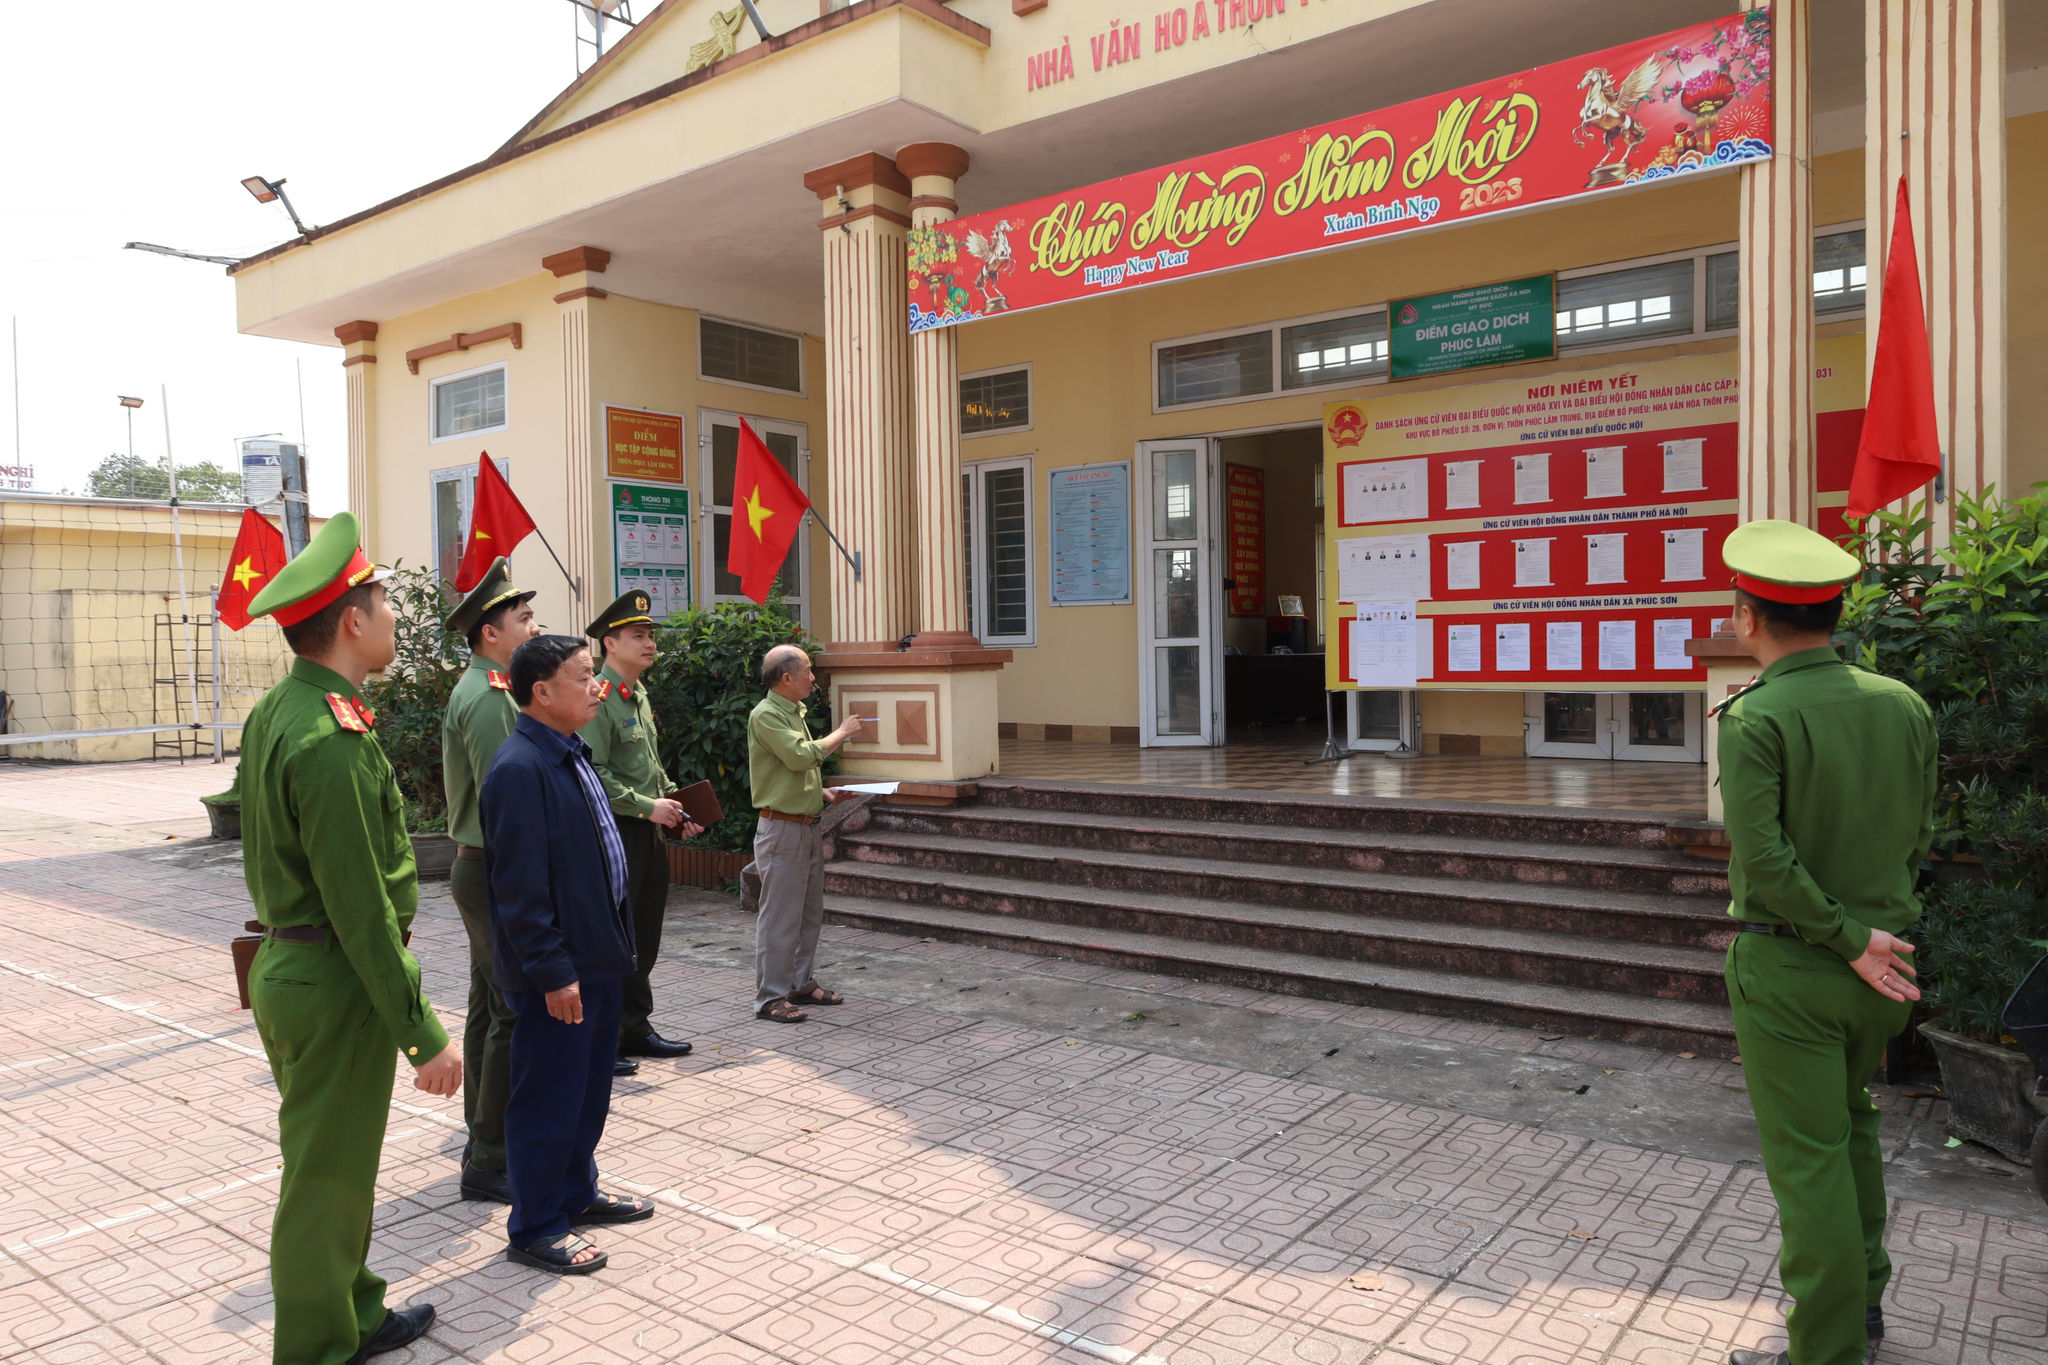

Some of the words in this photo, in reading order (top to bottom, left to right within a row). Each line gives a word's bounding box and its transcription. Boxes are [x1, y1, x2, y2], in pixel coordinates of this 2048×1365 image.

[1027, 35, 1075, 92] NHÀ
[1090, 18, 1141, 72] VĂN
[1029, 200, 1128, 278] Chúc
[1129, 164, 1268, 248] Mừng
[1273, 129, 1395, 217] Năm
[1401, 92, 1540, 190] Mới
[1323, 213, 1366, 237] Xuân
[1366, 201, 1403, 230] Bính
[1403, 195, 1440, 220] Ngọ
[1084, 263, 1125, 288] Happy
[1126, 256, 1157, 278] New
[1158, 248, 1190, 270] Year
[1415, 323, 1448, 341] ĐIỂM
[1451, 318, 1490, 336] GIAO
[1492, 311, 1530, 330] DỊCH
[1441, 336, 1473, 353] PHÚC
[1375, 420, 1394, 431] DANH
[1395, 417, 1413, 428] SÁCH
[1442, 411, 1457, 422] VIÊN
[1473, 406, 1489, 420] BIỂU
[1491, 404, 1510, 418] QUỐC
[1512, 402, 1525, 416] HỘI
[1526, 400, 1546, 412] KHÓA
[1549, 400, 1561, 411] XVI
[1563, 397, 1573, 409] VÀ
[1574, 397, 1588, 409] ĐẠI
[1589, 391, 1607, 406] BIỂU
[1609, 391, 1623, 405] HỘI
[1625, 387, 1648, 402] ĐỒNG
[1649, 386, 1673, 399] NHÂN
[1675, 383, 1693, 396] DÂN
[1695, 380, 1712, 394] CÁC
[1714, 377, 1732, 392] CẤP
[1815, 367, 1832, 379] 031
[1528, 384, 1555, 399] NƠI
[1561, 379, 1603, 395] NIÊM
[1609, 372, 1639, 389] YẾT
[1405, 430, 1418, 440] KHU
[1507, 417, 1523, 429] THÔN
[1525, 415, 1542, 427] PHÚC
[1544, 412, 1558, 424] LÂM
[1598, 405, 1616, 419] ĐIỂM
[1652, 399, 1668, 412] NHÀ
[1670, 397, 1684, 410] VĂN
[1703, 393, 1722, 406] THÔN
[1724, 391, 1739, 404] PHÚ
[1520, 429, 1536, 441] ỨNG
[1538, 427, 1549, 439] CỬ
[1550, 424, 1568, 438] VIÊN
[1570, 424, 1583, 437] ĐẠI
[1585, 420, 1603, 434] BIỂU
[1605, 419, 1627, 432] QUỐC
[1629, 418, 1644, 431] HỘI
[633, 427, 657, 442] ĐIỂM
[262, 455, 281, 466] TÂ
[1483, 519, 1498, 529] ỨNG
[1500, 517, 1511, 528] CỬ
[1512, 517, 1529, 527] VIÊN
[1531, 515, 1544, 526] HỘI
[1545, 513, 1567, 525] ĐỒNG
[1568, 513, 1591, 524] NHÂN
[1592, 511, 1610, 522] DÂN
[1612, 509, 1638, 520] THÀNH
[1640, 506, 1657, 518] PHỐ
[1659, 506, 1671, 517] HÀ
[1673, 505, 1688, 517] NỘI
[1493, 599, 1508, 610] ỨNG
[1510, 598, 1521, 609] CỬ
[1522, 598, 1539, 609] VIÊN
[1541, 597, 1554, 609] HỘI
[1556, 595, 1577, 608] ĐỒNG
[1579, 595, 1601, 607] NHÂN
[1603, 595, 1620, 606] DÂN
[1622, 594, 1634, 606] XÃ
[1635, 594, 1658, 605] PHÚC
[1660, 594, 1678, 605] SƠN
